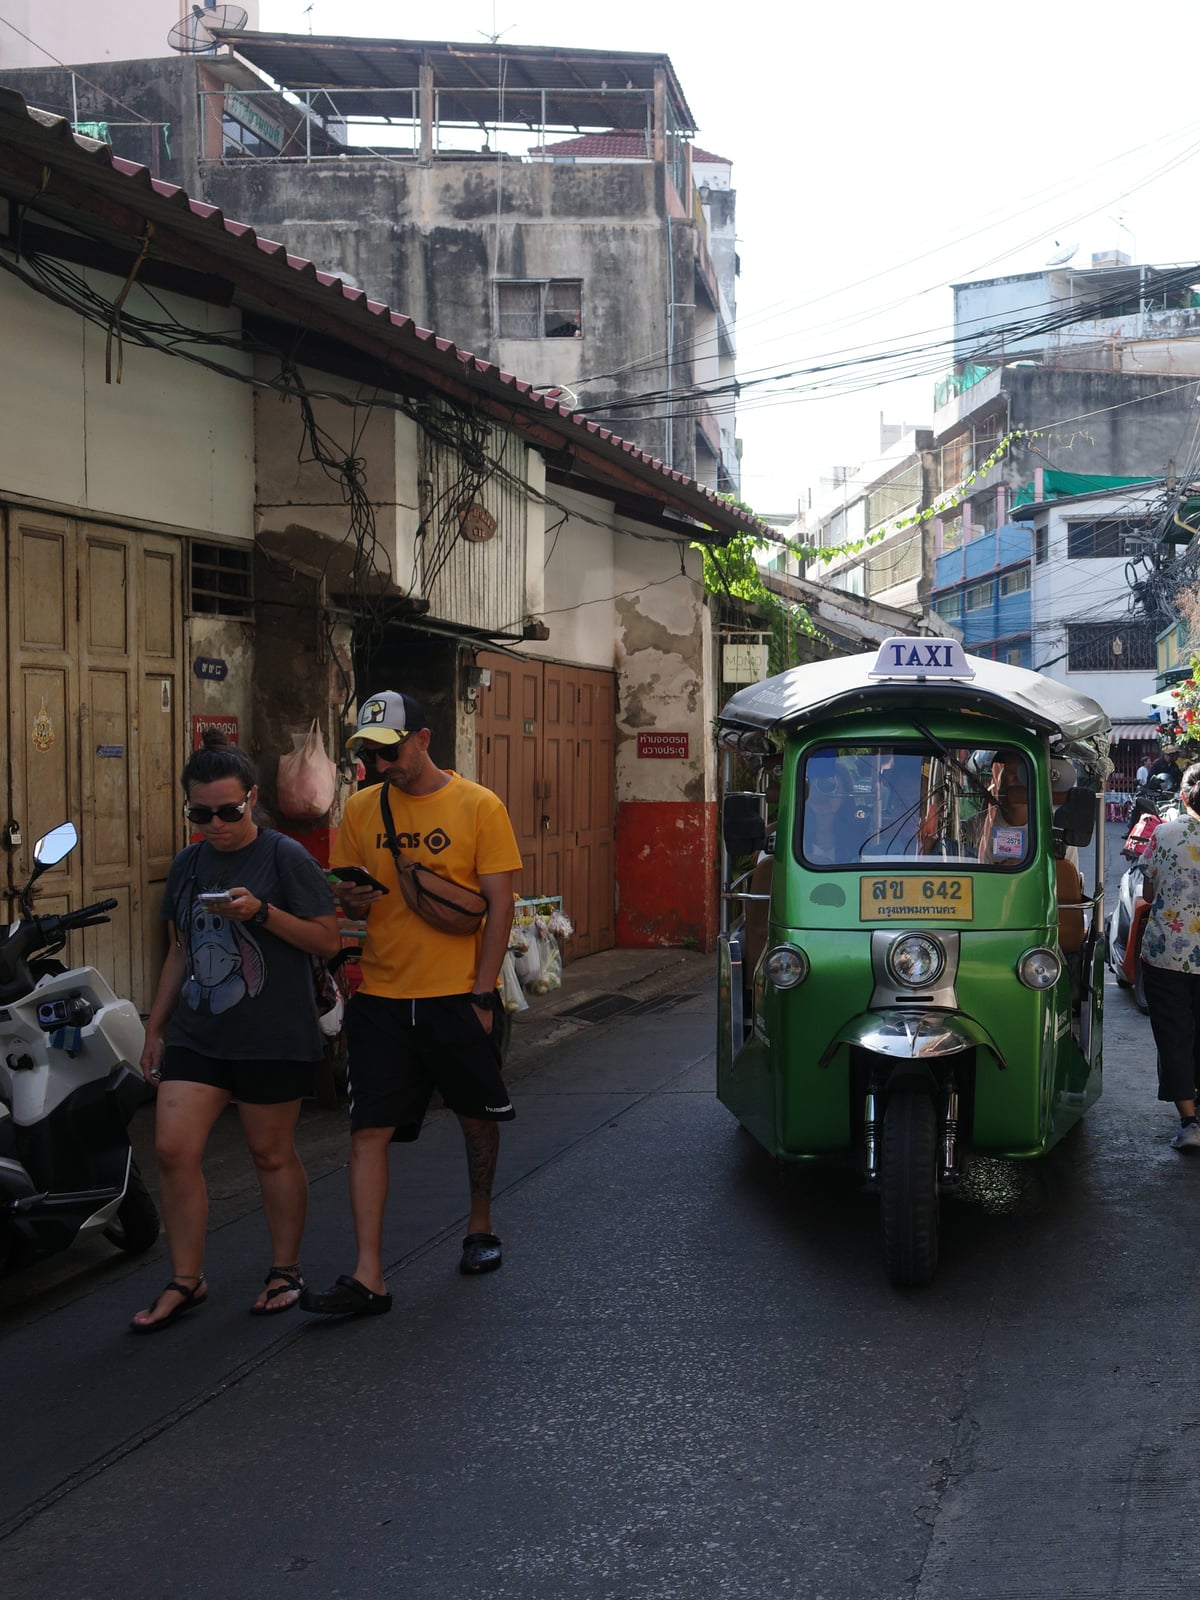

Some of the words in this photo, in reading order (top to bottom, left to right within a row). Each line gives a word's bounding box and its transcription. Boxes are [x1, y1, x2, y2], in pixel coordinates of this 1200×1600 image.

[889, 644, 954, 667] TAXI
[640, 734, 687, 745] ห้ามจอดรถ
[642, 745, 685, 757] ขวางประตู
[872, 879, 904, 900] สข
[922, 880, 962, 900] 642
[878, 905, 956, 917] กรุงเทพมหานคร
